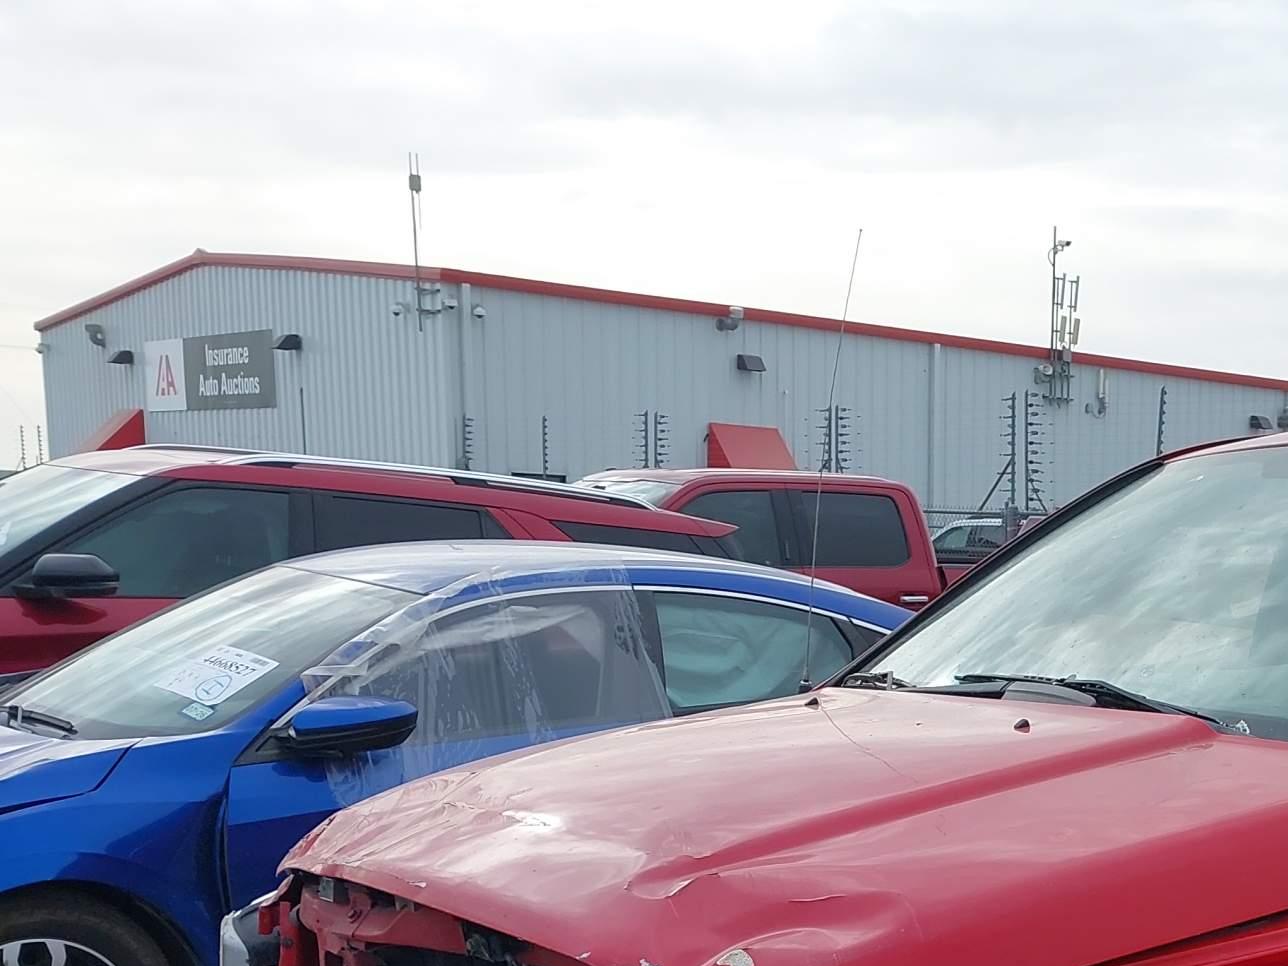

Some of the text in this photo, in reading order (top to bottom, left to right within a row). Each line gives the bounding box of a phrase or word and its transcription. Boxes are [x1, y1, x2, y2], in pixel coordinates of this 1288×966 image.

[205, 343, 249, 366] Insurance
[199, 371, 260, 396] Auto Auctions
